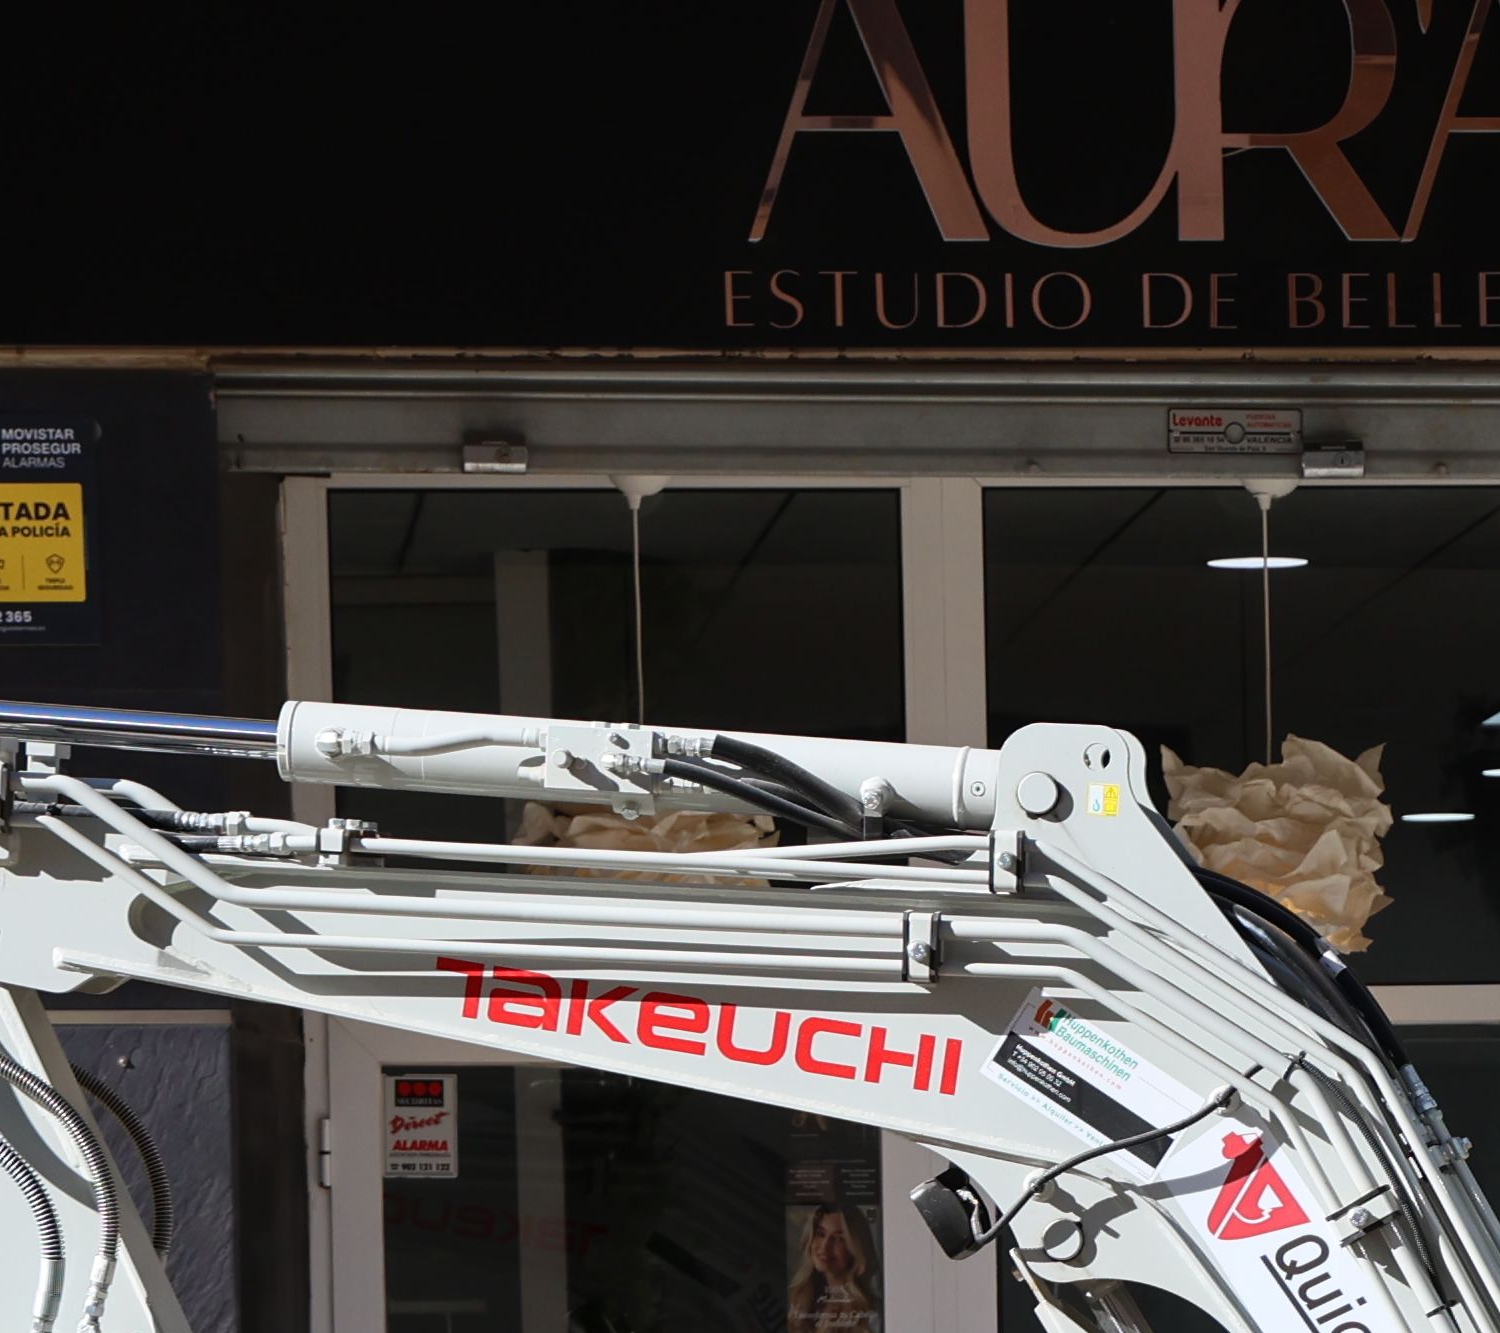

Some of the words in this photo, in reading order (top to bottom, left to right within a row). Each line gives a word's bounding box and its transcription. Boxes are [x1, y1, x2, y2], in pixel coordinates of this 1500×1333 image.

[725, 270, 1092, 330] ESTUDIO
[1143, 272, 1239, 329] DE
[1173, 413, 1223, 427] Levante
[1, 428, 75, 440] MOVISTAR
[1247, 436, 1293, 444] VALENCIA
[1, 443, 82, 454] PROSEGUR
[2, 457, 66, 468] ALARMAS
[0, 525, 9, 538] A
[11, 522, 71, 538] POLICÍA
[5, 611, 32, 622] 365
[436, 956, 963, 1096] TAKEUCHI
[1062, 1013, 1139, 1069] Huppenkothen
[1055, 1025, 1131, 1082] Baumaschinen
[390, 1111, 450, 1134] Direct
[393, 1140, 449, 1151] ALARMA
